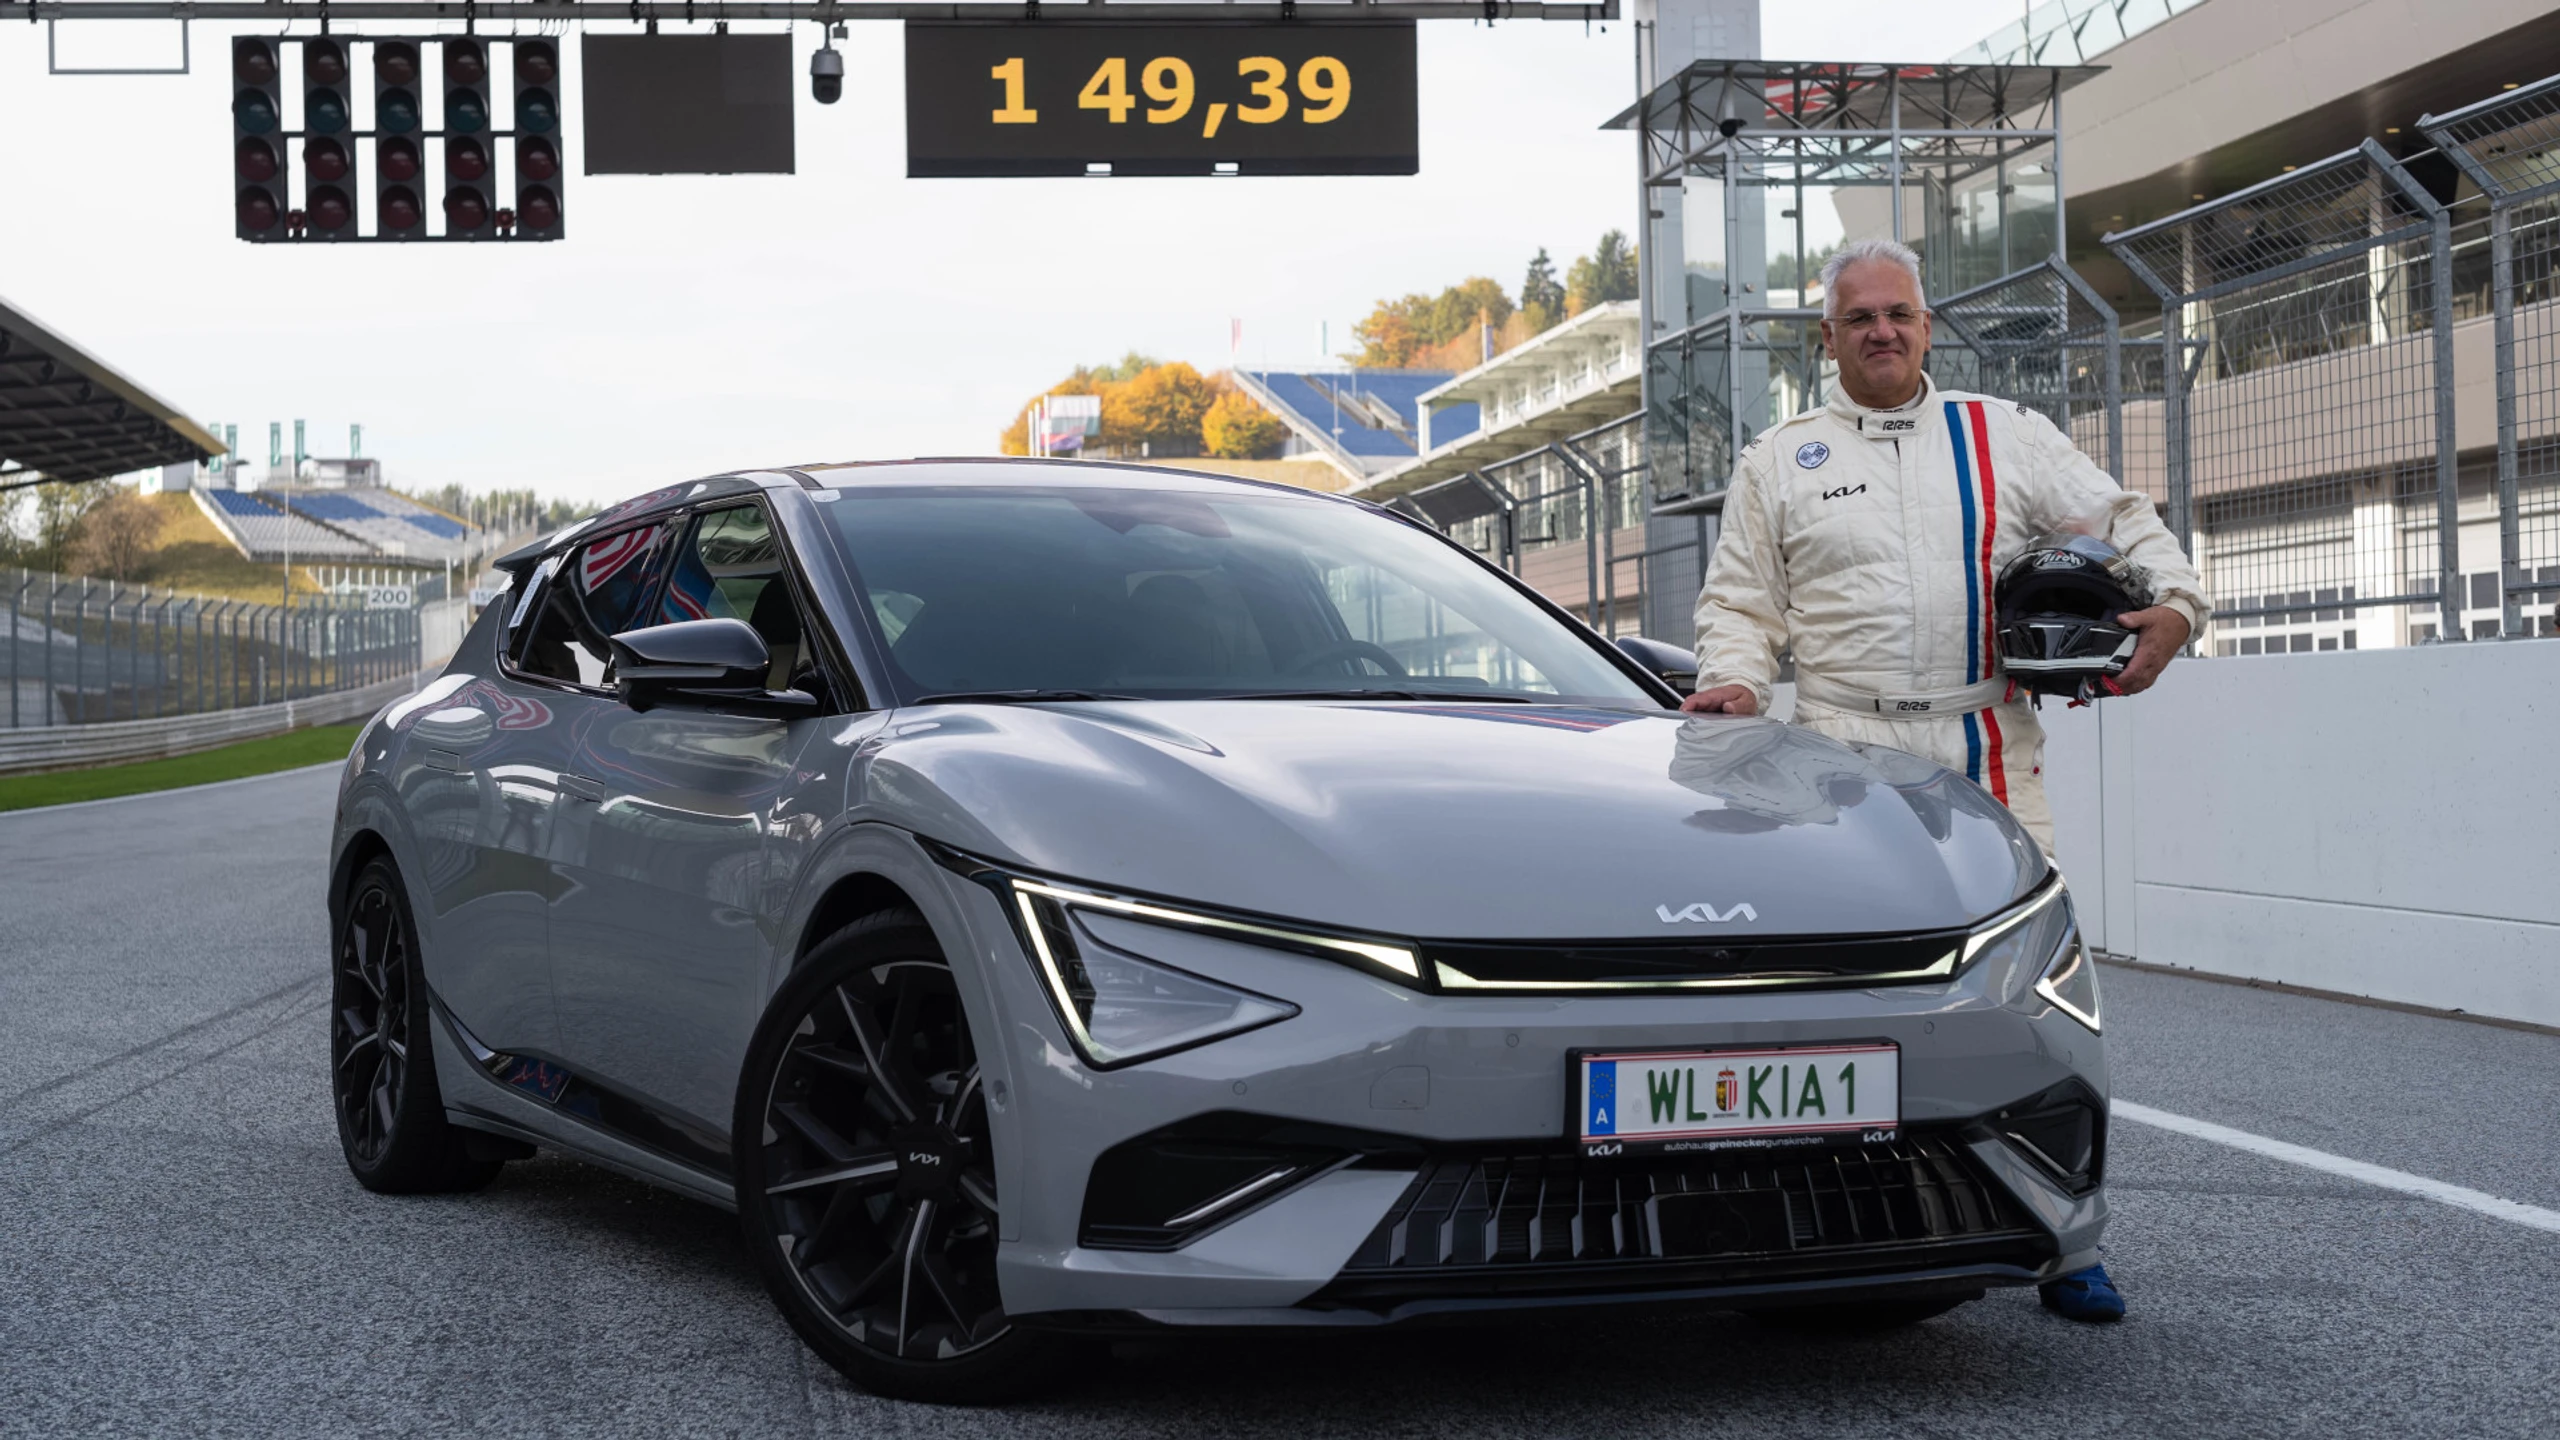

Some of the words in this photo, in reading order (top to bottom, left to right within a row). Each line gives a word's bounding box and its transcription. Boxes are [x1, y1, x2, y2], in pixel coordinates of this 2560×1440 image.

[991, 57, 1038, 124] 1
[1078, 55, 1352, 139] 49,39
[1882, 420, 1916, 431] RRS
[1822, 483, 1867, 501] KIA
[2036, 553, 2081, 565] Airoh
[371, 590, 408, 604] 200
[1896, 701, 1932, 711] RRS
[1655, 902, 1758, 923] KIA
[1647, 1067, 1708, 1124] WL
[1595, 1108, 1608, 1124] A
[1863, 1130, 1896, 1143] KIA
[1587, 1143, 1623, 1157] KIA
